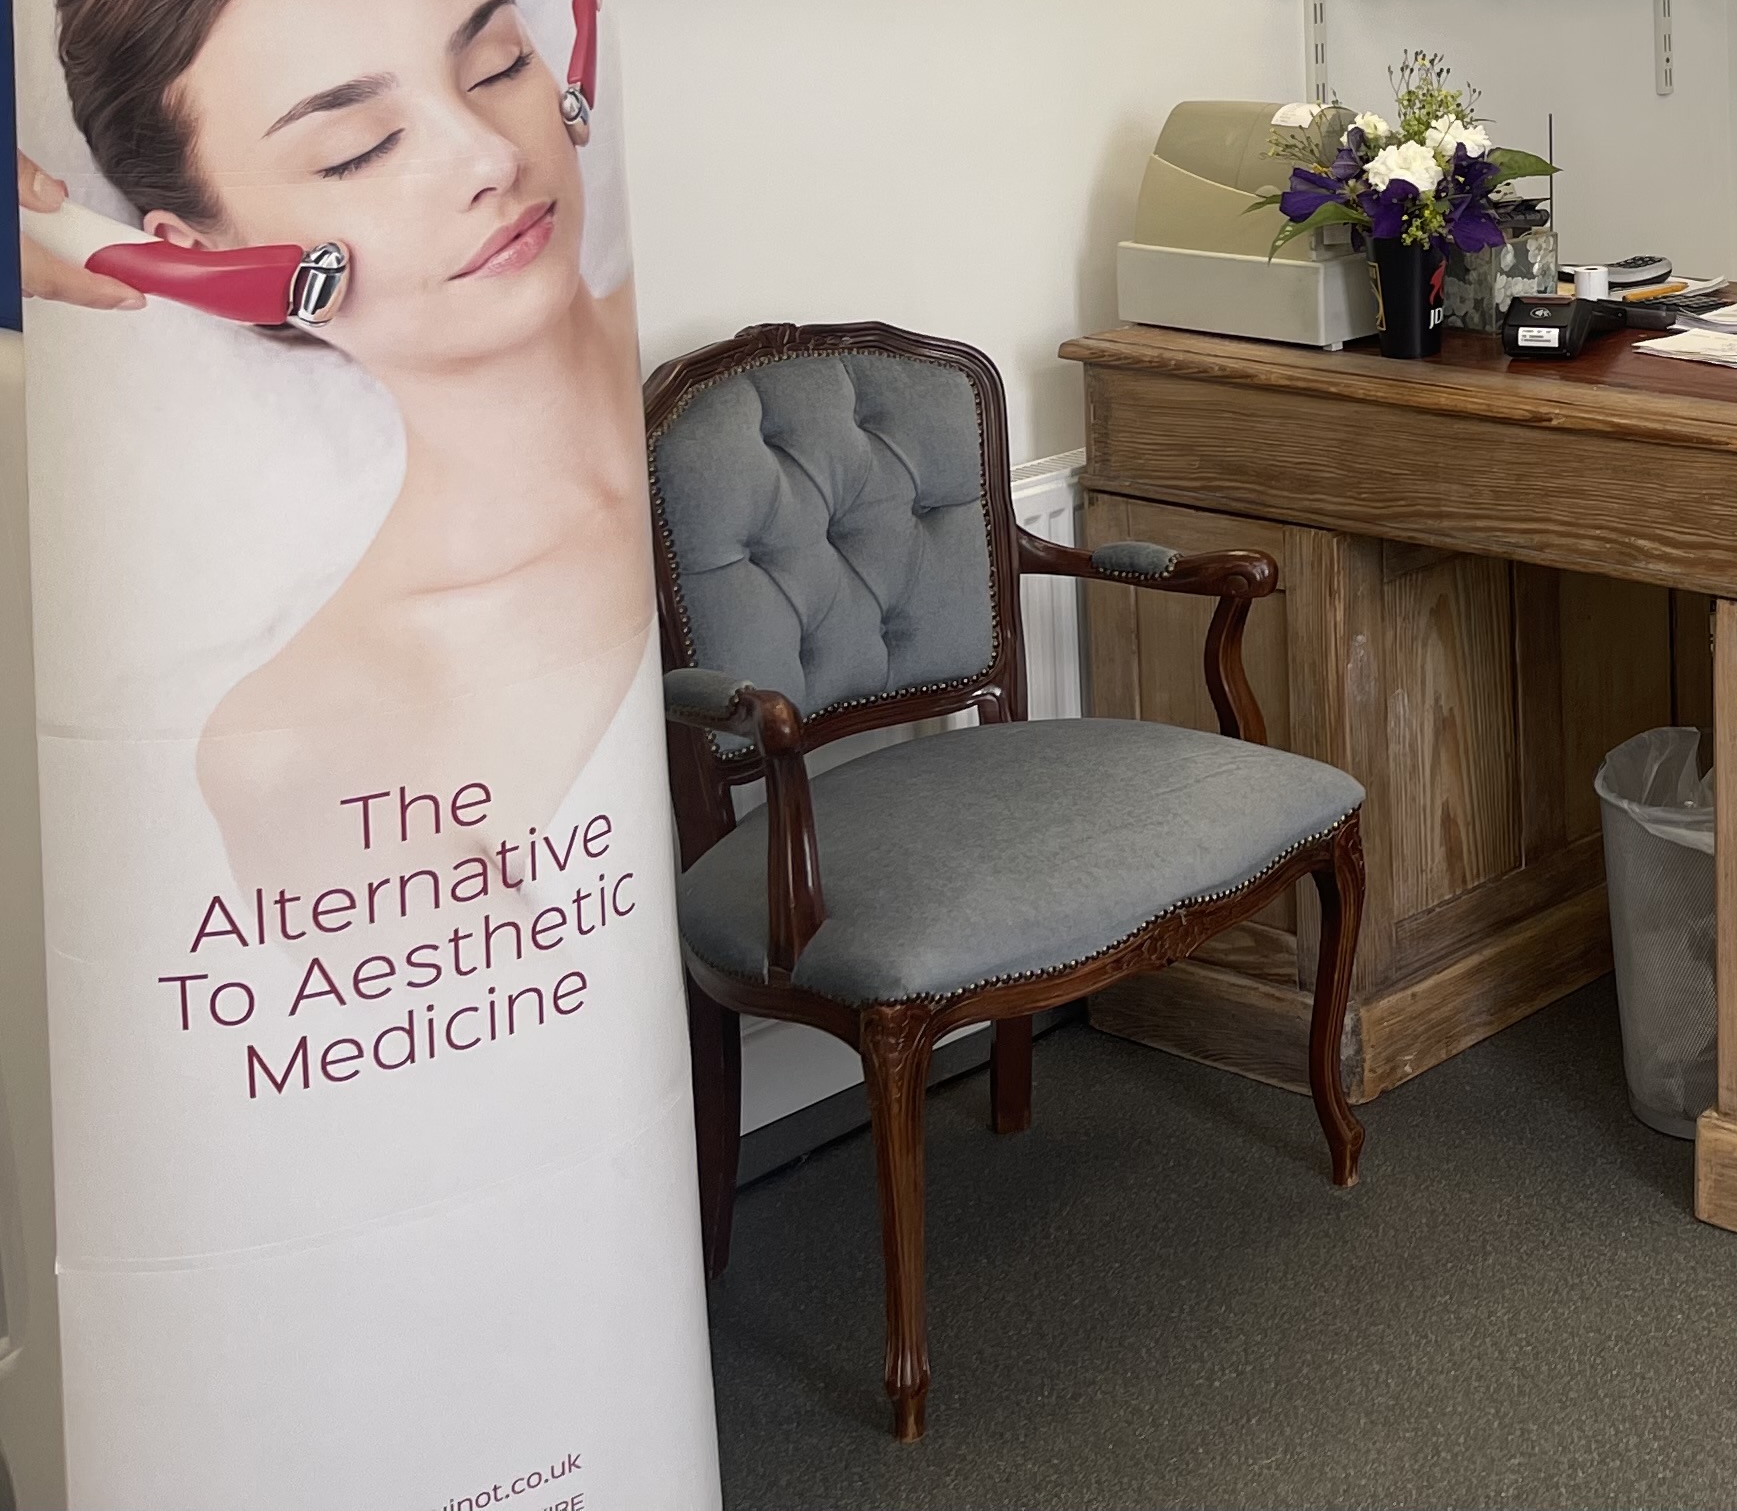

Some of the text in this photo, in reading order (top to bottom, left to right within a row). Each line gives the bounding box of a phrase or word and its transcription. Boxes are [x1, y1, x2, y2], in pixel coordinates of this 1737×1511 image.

[340, 781, 493, 851] The
[190, 813, 612, 954] Alternative
[158, 871, 637, 1031] To Aesthetic
[246, 970, 589, 1099] Medicine
[443, 1453, 583, 1511] inot.co.uk
